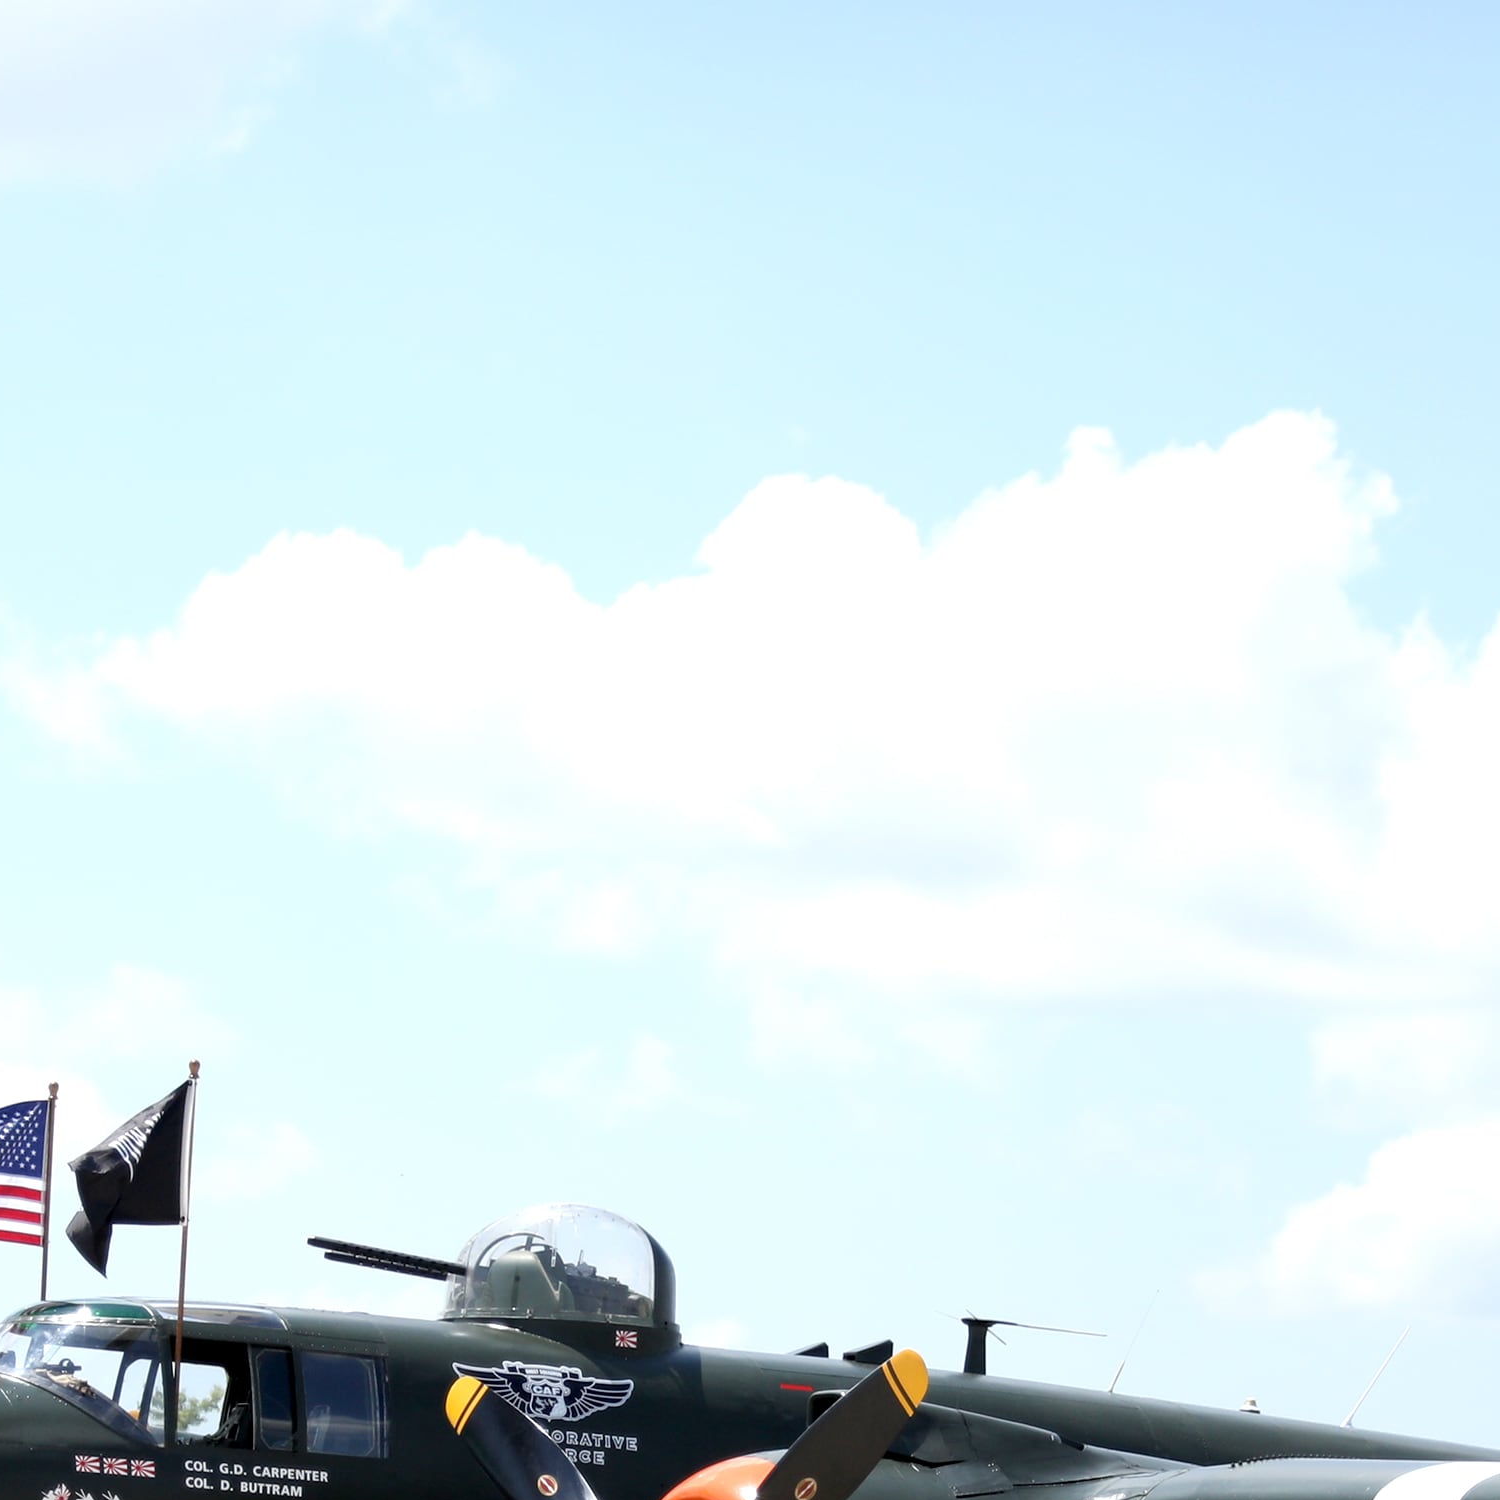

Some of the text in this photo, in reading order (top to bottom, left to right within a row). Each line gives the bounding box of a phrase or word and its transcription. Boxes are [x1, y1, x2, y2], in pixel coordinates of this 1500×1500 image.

[532, 1385, 561, 1396] CAF
[550, 1430, 638, 1451] ORATIVE
[565, 1448, 605, 1465] RCE
[184, 1460, 328, 1483] COL. G.D. CARPENTER
[185, 1477, 302, 1497] COL. D. BUTTRAM
